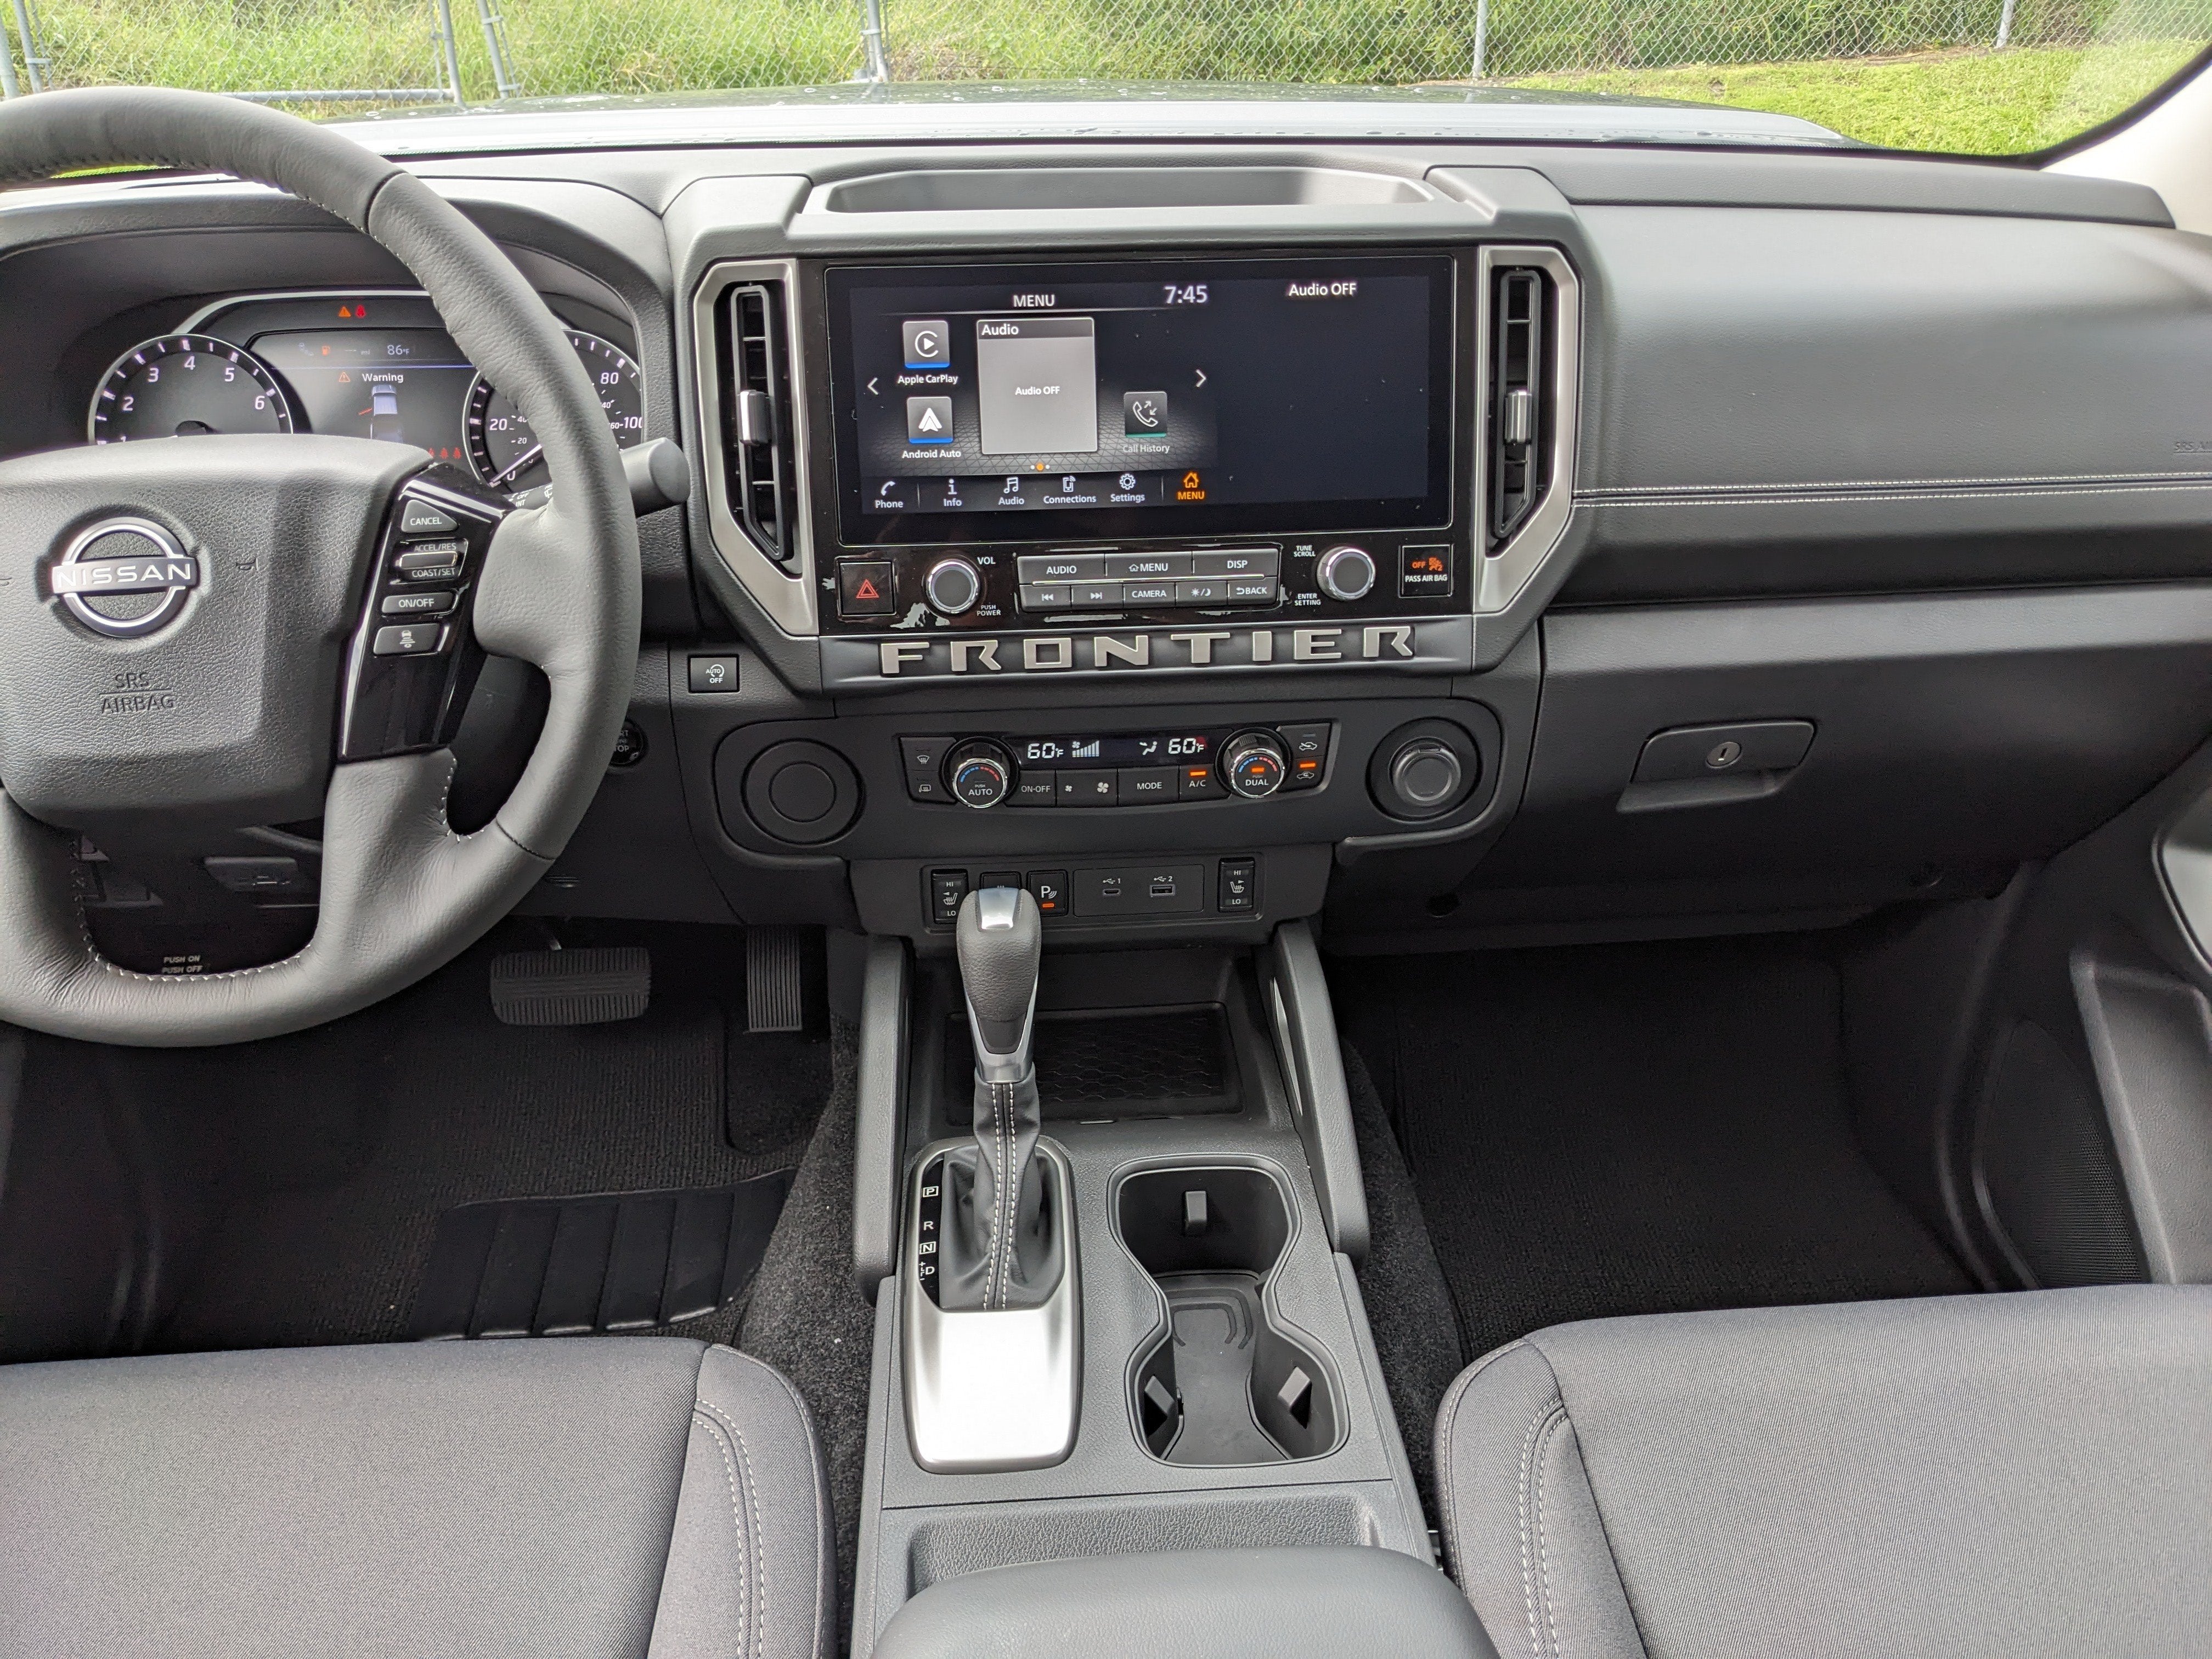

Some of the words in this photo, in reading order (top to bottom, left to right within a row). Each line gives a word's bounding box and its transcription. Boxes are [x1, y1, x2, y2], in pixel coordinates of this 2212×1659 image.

[1165, 285, 1207, 304] 7:45
[1289, 283, 1328, 297] Audio
[1331, 283, 1358, 296] OFF
[1013, 294, 1056, 307] MENU
[981, 324, 1019, 336] Audio
[184, 356, 195, 370] 4
[148, 368, 159, 382] 3
[224, 368, 234, 382] 5
[362, 373, 404, 383] Warning
[600, 372, 619, 385] 80
[898, 375, 924, 386] Apple
[926, 374, 958, 385] CarPlay
[1015, 386, 1041, 396] Audio
[1043, 386, 1060, 395] OFF
[122, 397, 134, 411] 2
[255, 396, 265, 410] 6
[489, 418, 507, 431] 20
[1122, 444, 1138, 454] Call
[1140, 443, 1170, 455] History
[902, 449, 937, 460] Android
[939, 449, 961, 459] Auto
[1043, 494, 1096, 504] Connections
[1110, 493, 1145, 503] Settings
[1177, 491, 1205, 500] MENU
[875, 498, 904, 509] Phone
[944, 498, 962, 507] Info
[998, 496, 1024, 506] Audio
[410, 517, 442, 526] CANCEL
[414, 543, 456, 552] ACCEL/RES
[977, 556, 996, 565] VOL
[1227, 560, 1248, 569] DISP
[1412, 560, 1426, 569] OFF
[1046, 565, 1077, 574] AUDIO
[1140, 563, 1169, 572] MENU
[57, 562, 191, 589] NISSAN
[412, 568, 455, 578] COAST/SET
[1131, 590, 1167, 598] CAMERA
[1245, 586, 1267, 595] BACK
[398, 599, 434, 608] ON/OFF
[881, 625, 1413, 674] FRONTIER
[115, 673, 151, 689] SRS
[101, 695, 176, 713] AIRBAG
[1137, 782, 1163, 790] MODE
[1245, 778, 1269, 787] DUAL
[923, 1221, 934, 1231] R
[922, 1244, 933, 1252] N
[925, 1266, 935, 1275] D
